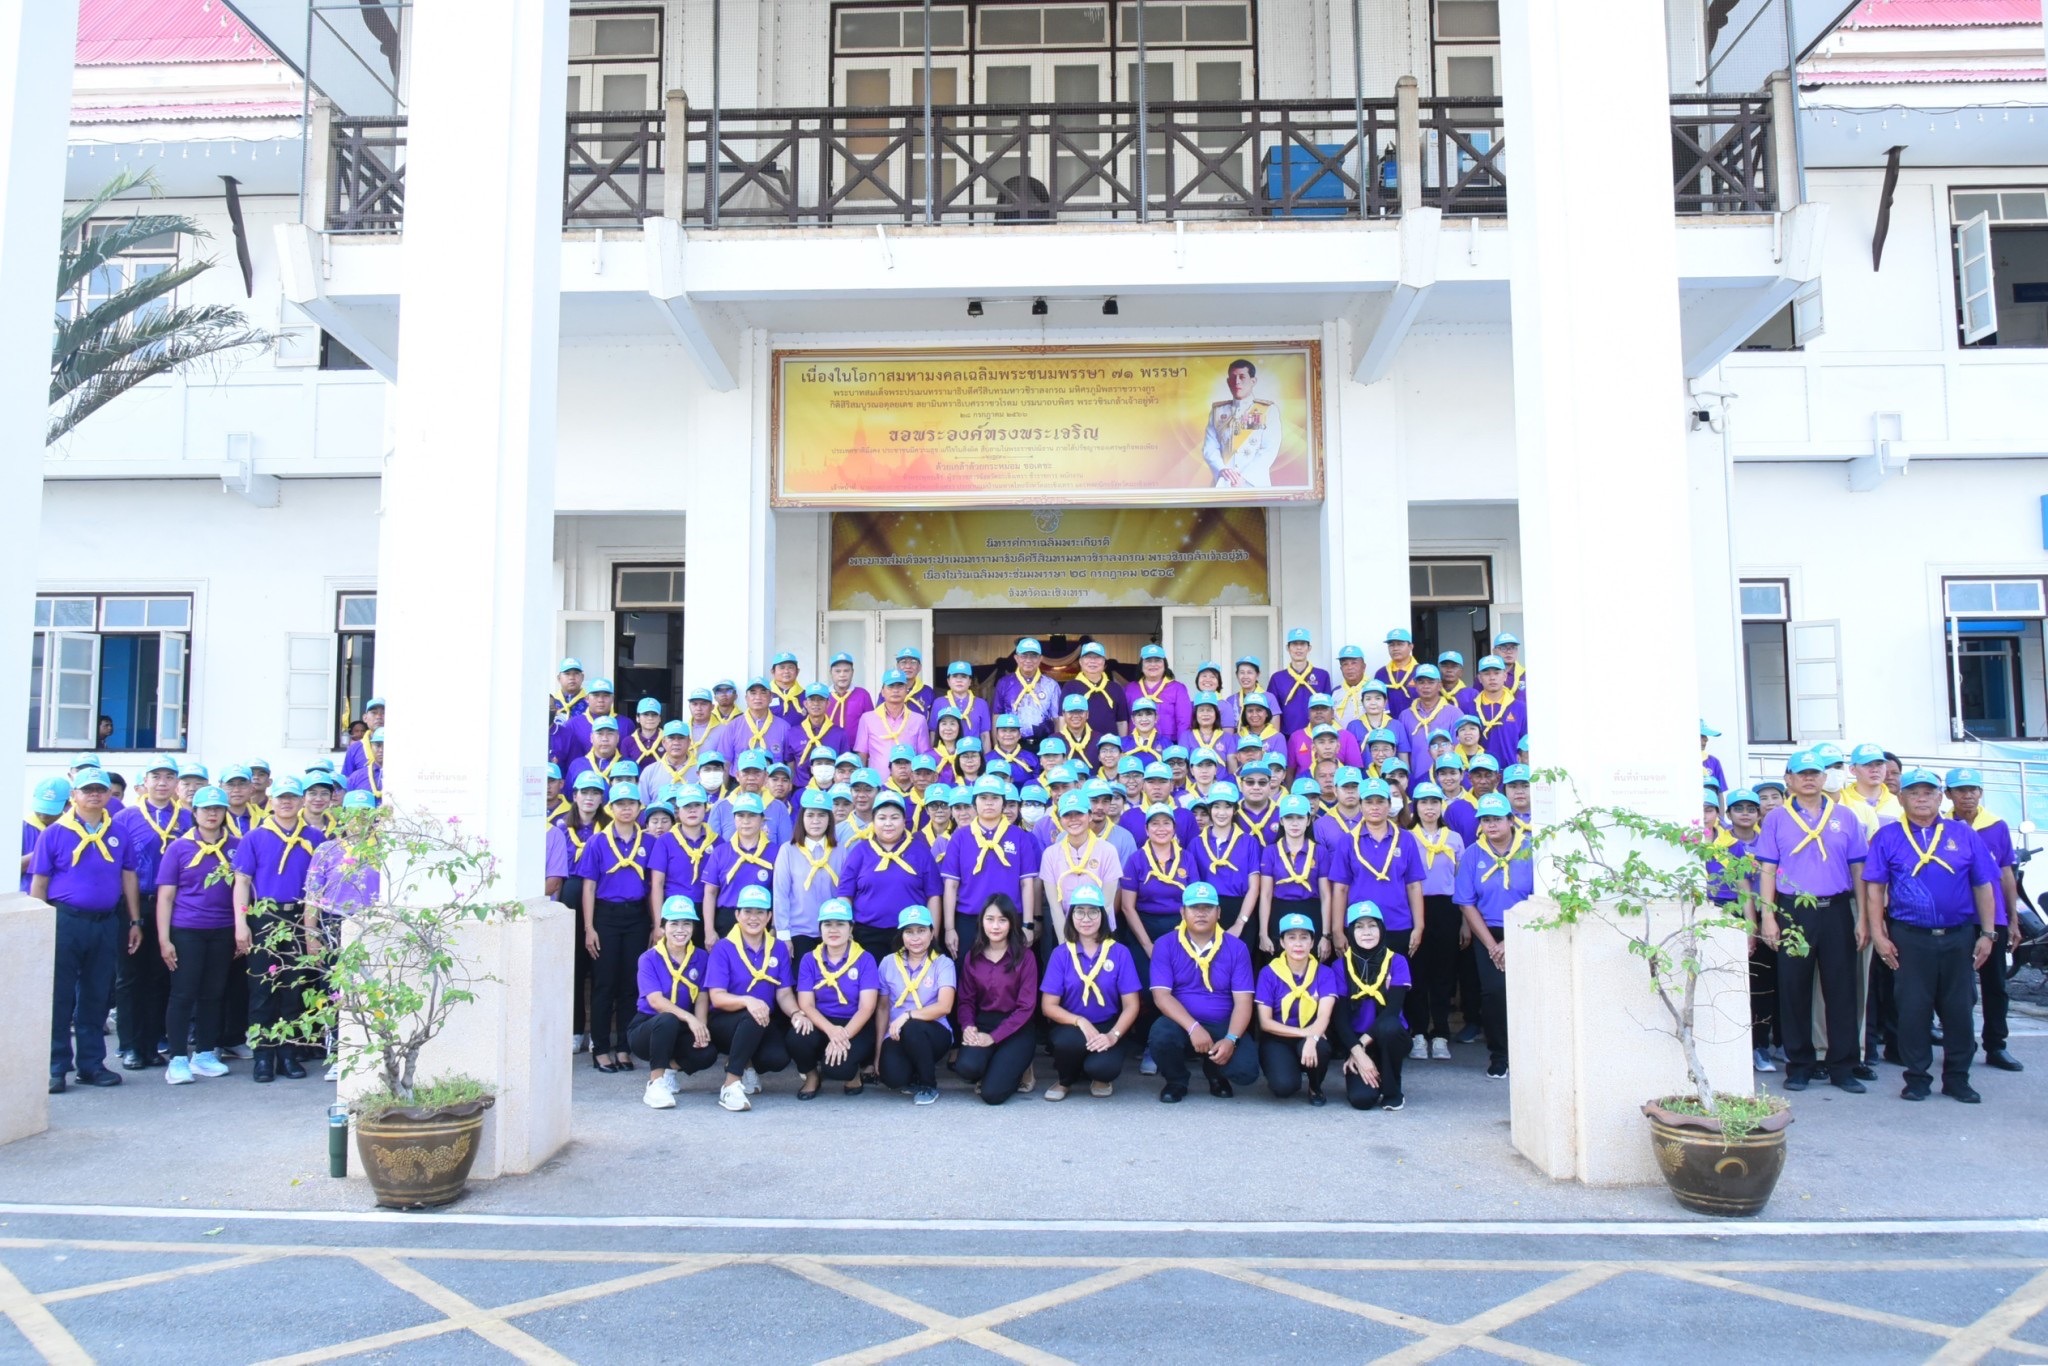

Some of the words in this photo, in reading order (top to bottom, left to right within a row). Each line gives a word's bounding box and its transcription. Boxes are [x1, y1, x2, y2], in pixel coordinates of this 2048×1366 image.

[801, 365, 1106, 383] เนื่องในโอกาสมหามงคลเฉลิมพระชนมพรรษา
[1111, 368, 1134, 379] ๗๑
[1141, 366, 1188, 379] พรรษา
[889, 422, 1099, 442] ขอพระองค์ทรงพระเจริญ
[986, 536, 1110, 548] นิทรรศการเฉลิมพระเกียรติ
[923, 566, 1066, 580] เนื่องในวันเฉลิมพระชนมพรรษา
[1090, 569, 1138, 580] กรกฎาคม
[1008, 586, 1089, 599] จังหวัดฉะเชิงเทรา
